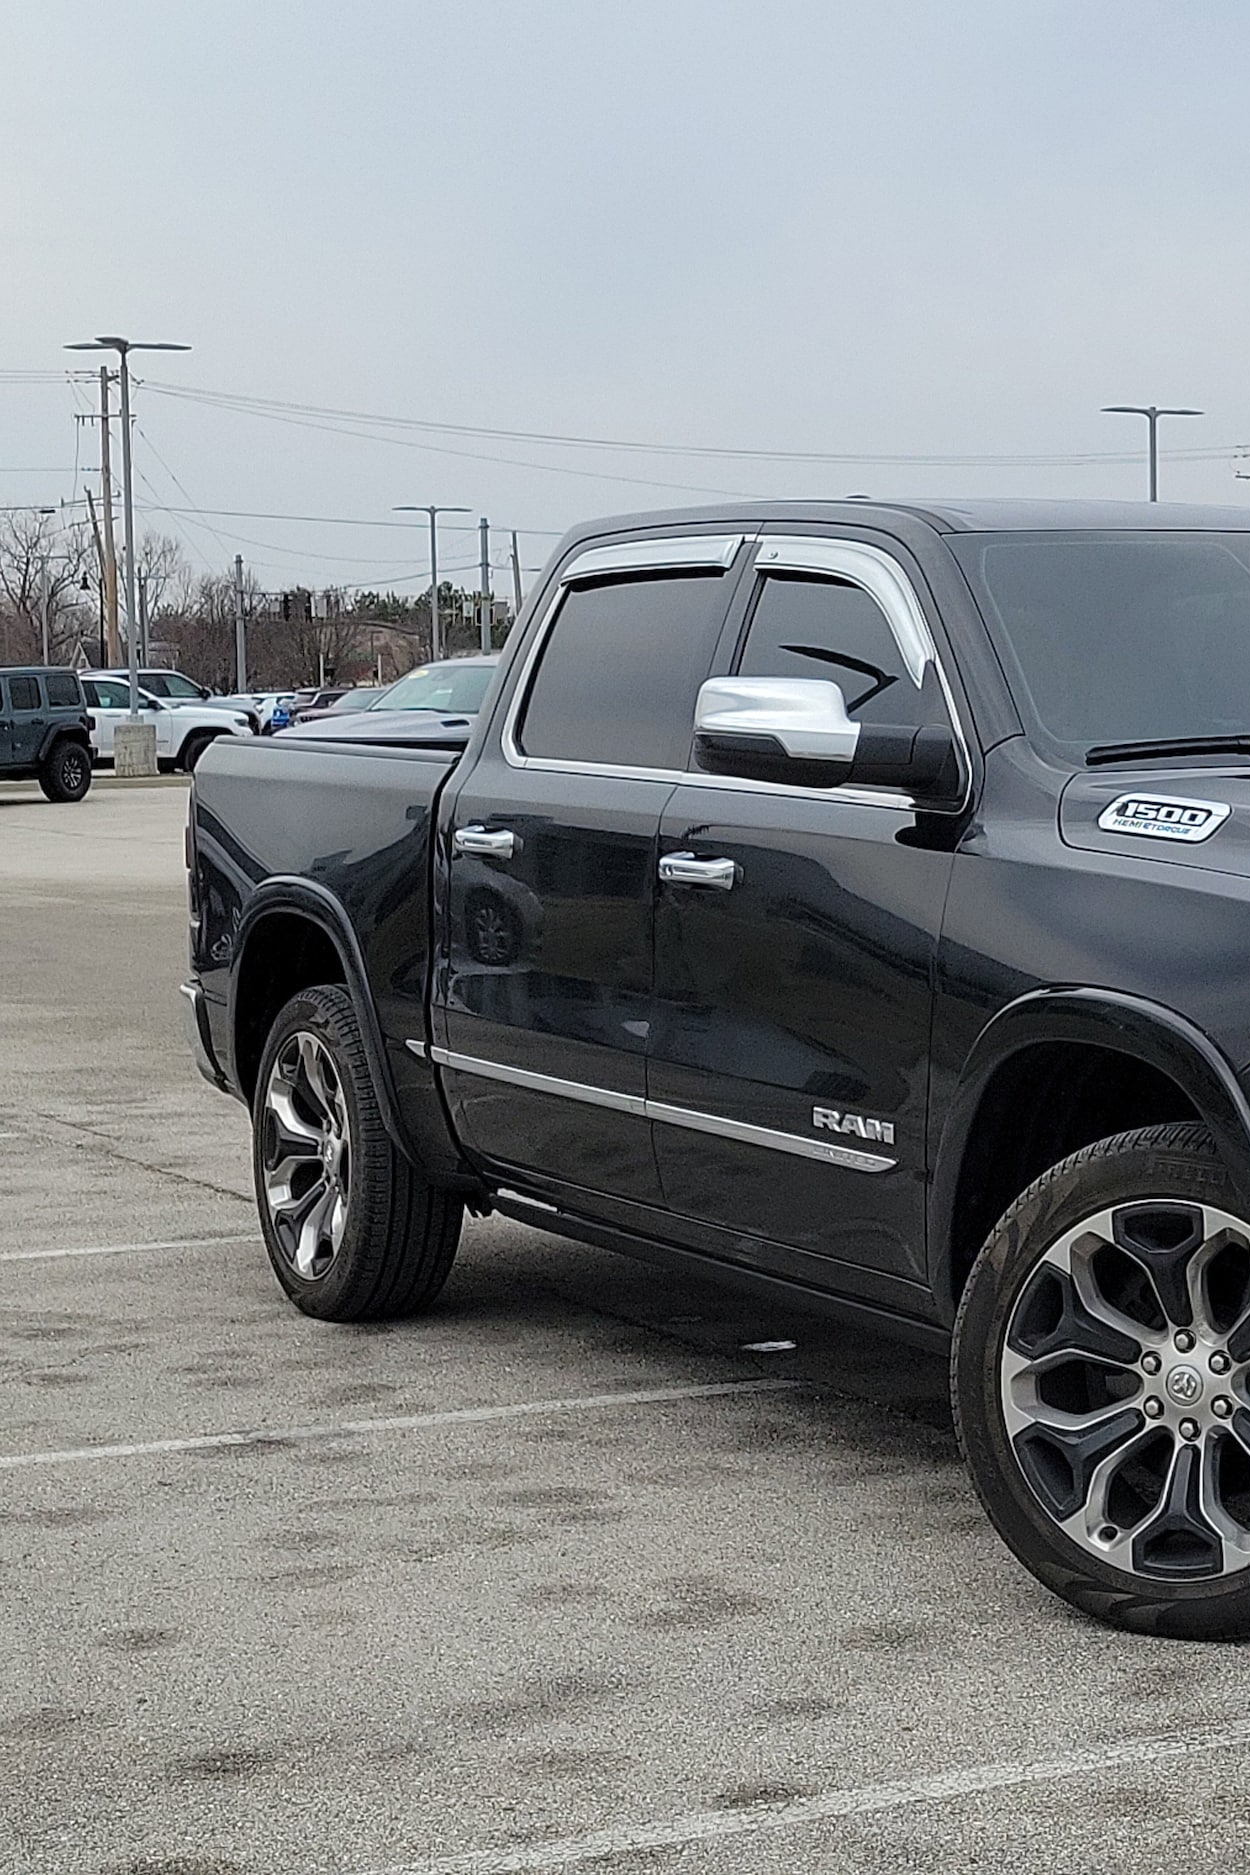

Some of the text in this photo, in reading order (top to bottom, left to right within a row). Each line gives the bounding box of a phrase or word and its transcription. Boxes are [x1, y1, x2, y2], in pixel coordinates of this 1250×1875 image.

[1112, 818, 1143, 829] HEMI
[1124, 801, 1209, 825] 1500
[813, 1106, 895, 1145] RAM
